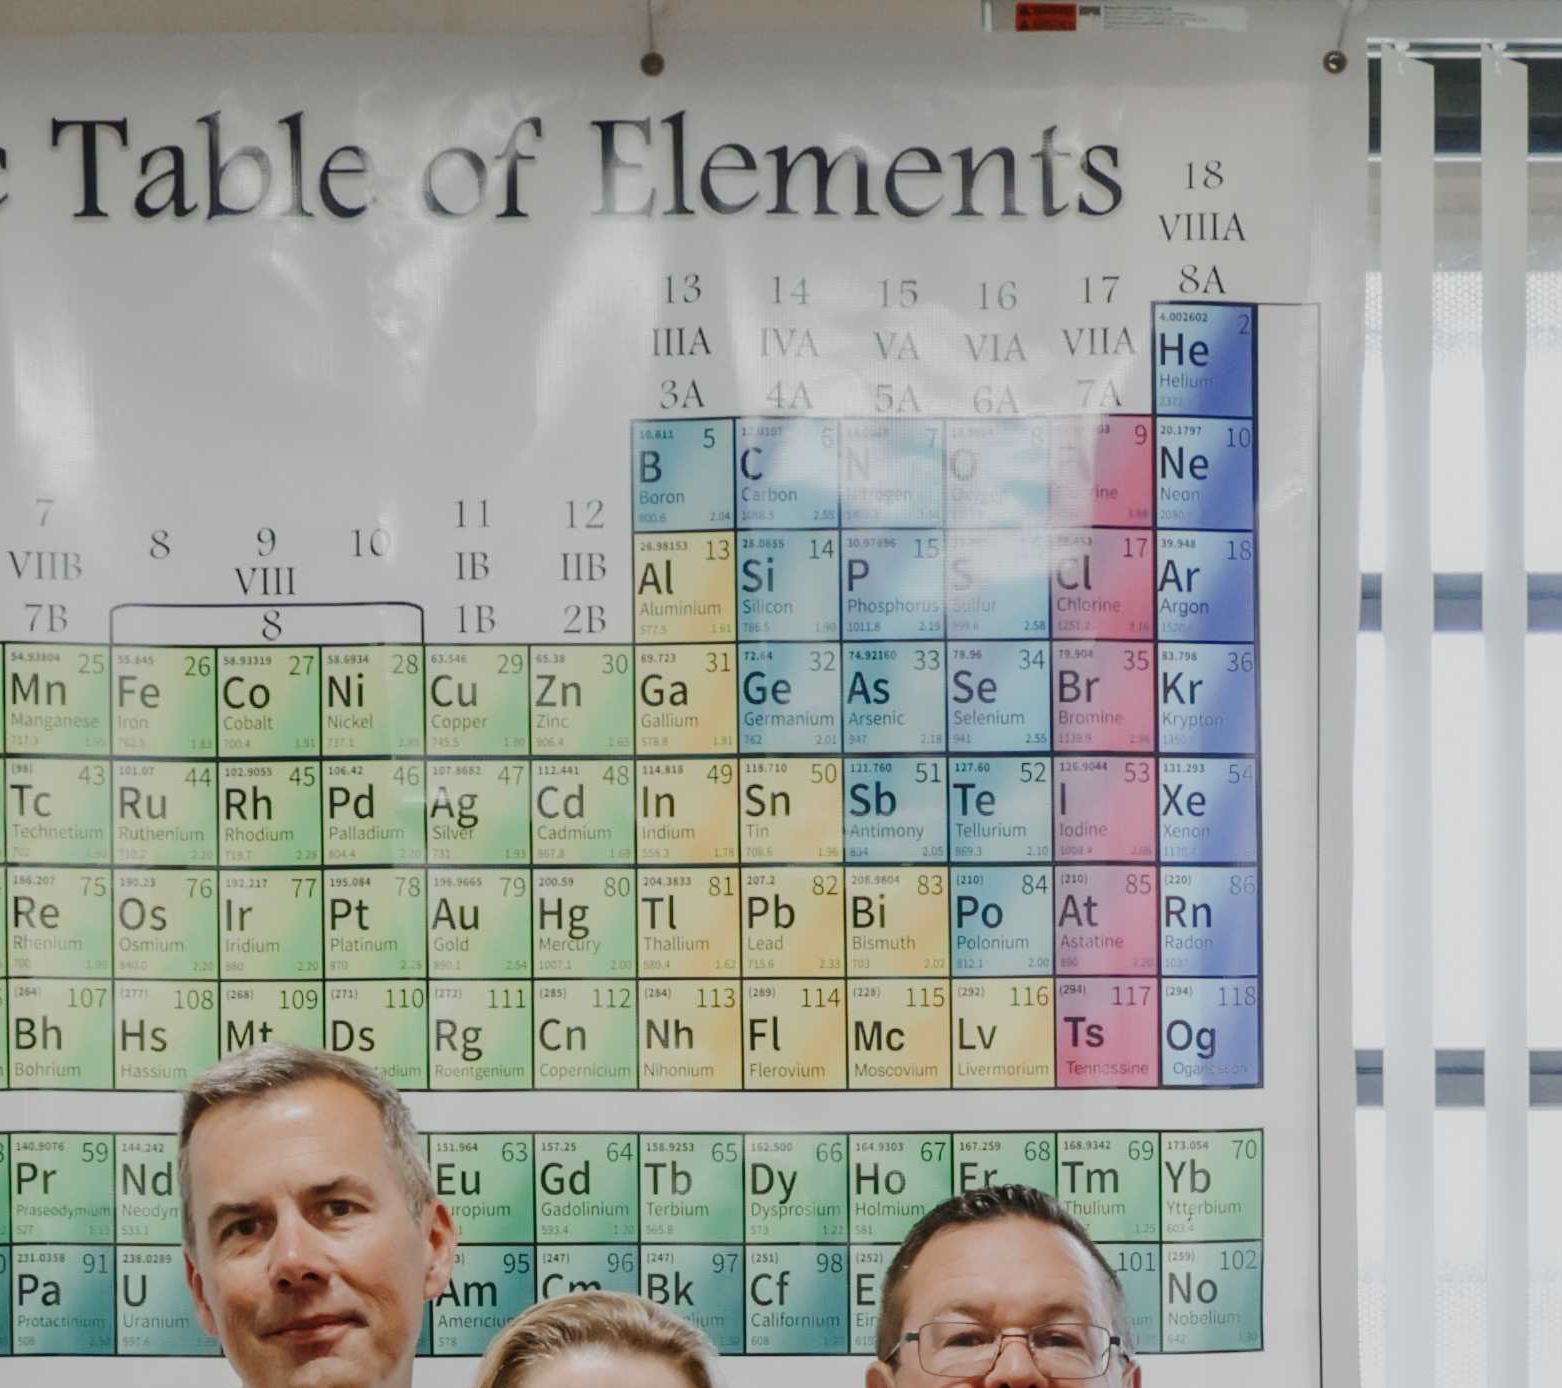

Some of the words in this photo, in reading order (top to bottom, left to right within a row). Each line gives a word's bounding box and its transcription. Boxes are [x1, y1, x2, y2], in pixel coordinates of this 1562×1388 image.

[52, 111, 367, 220] Table
[423, 117, 542, 218] of
[591, 110, 1122, 218] Elements
[1188, 161, 1223, 189] 18
[1160, 212, 1245, 241] VIIIA
[1179, 265, 1225, 294] 8A
[654, 327, 711, 356] IIIA
[1160, 333, 1208, 366] He
[661, 379, 704, 409] 3A
[235, 568, 294, 595] VIII
[638, 560, 673, 595] Al
[639, 600, 721, 616] Aluminium
[497, 654, 523, 674] 29
[431, 675, 476, 707] Cu
[743, 671, 791, 705] Ge
[431, 714, 487, 732] Copper
[744, 712, 834, 727] Germanium
[1020, 761, 1047, 784] 52
[953, 783, 995, 816] Te
[954, 822, 1026, 838] Tellurium
[748, 894, 795, 928] Pb
[748, 935, 783, 951] Lead
[959, 1018, 997, 1050] Lv
[958, 1062, 1049, 1076] Livermorium
[541, 1160, 589, 1195] Gd
[751, 1162, 798, 1205] Dy
[541, 1200, 629, 1216] Gadolinium
[751, 1201, 841, 1220] Dysprosium
